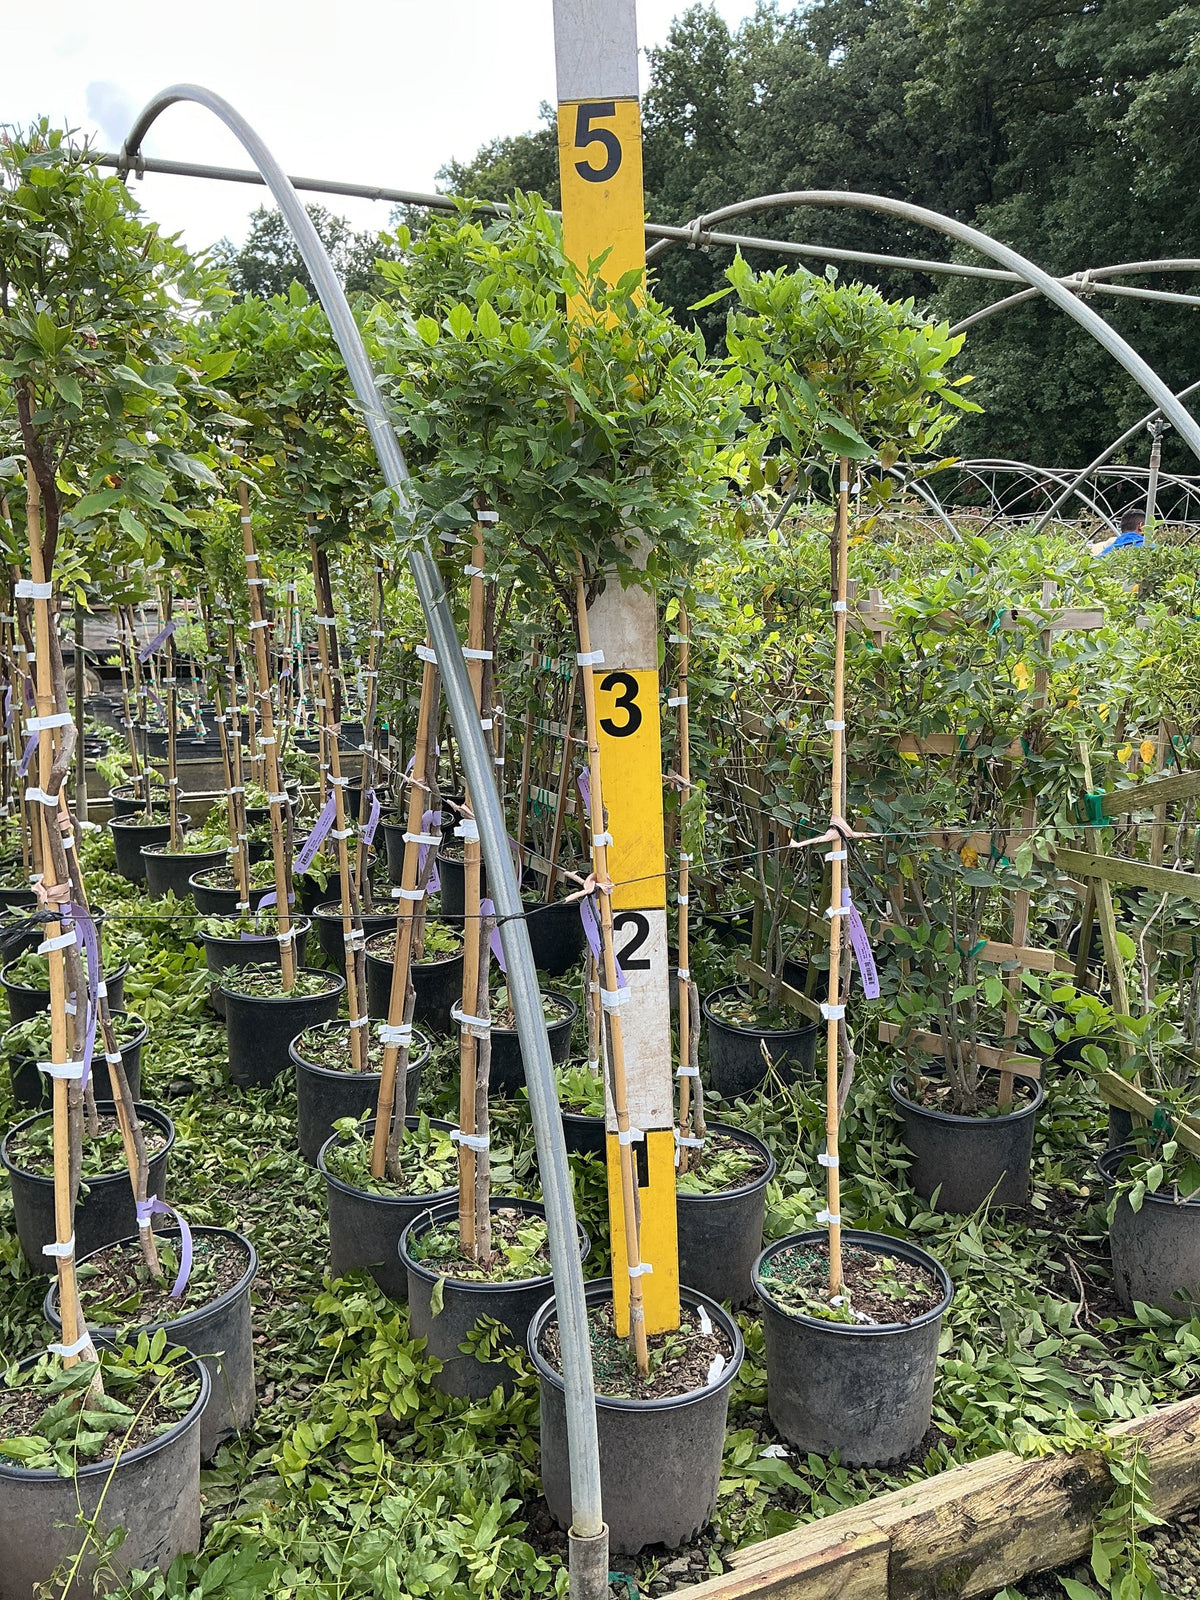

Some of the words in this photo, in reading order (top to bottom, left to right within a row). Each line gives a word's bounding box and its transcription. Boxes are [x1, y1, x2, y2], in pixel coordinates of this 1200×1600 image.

[574, 102, 621, 182] 5
[599, 672, 642, 737] 3
[613, 912, 650, 970] 2
